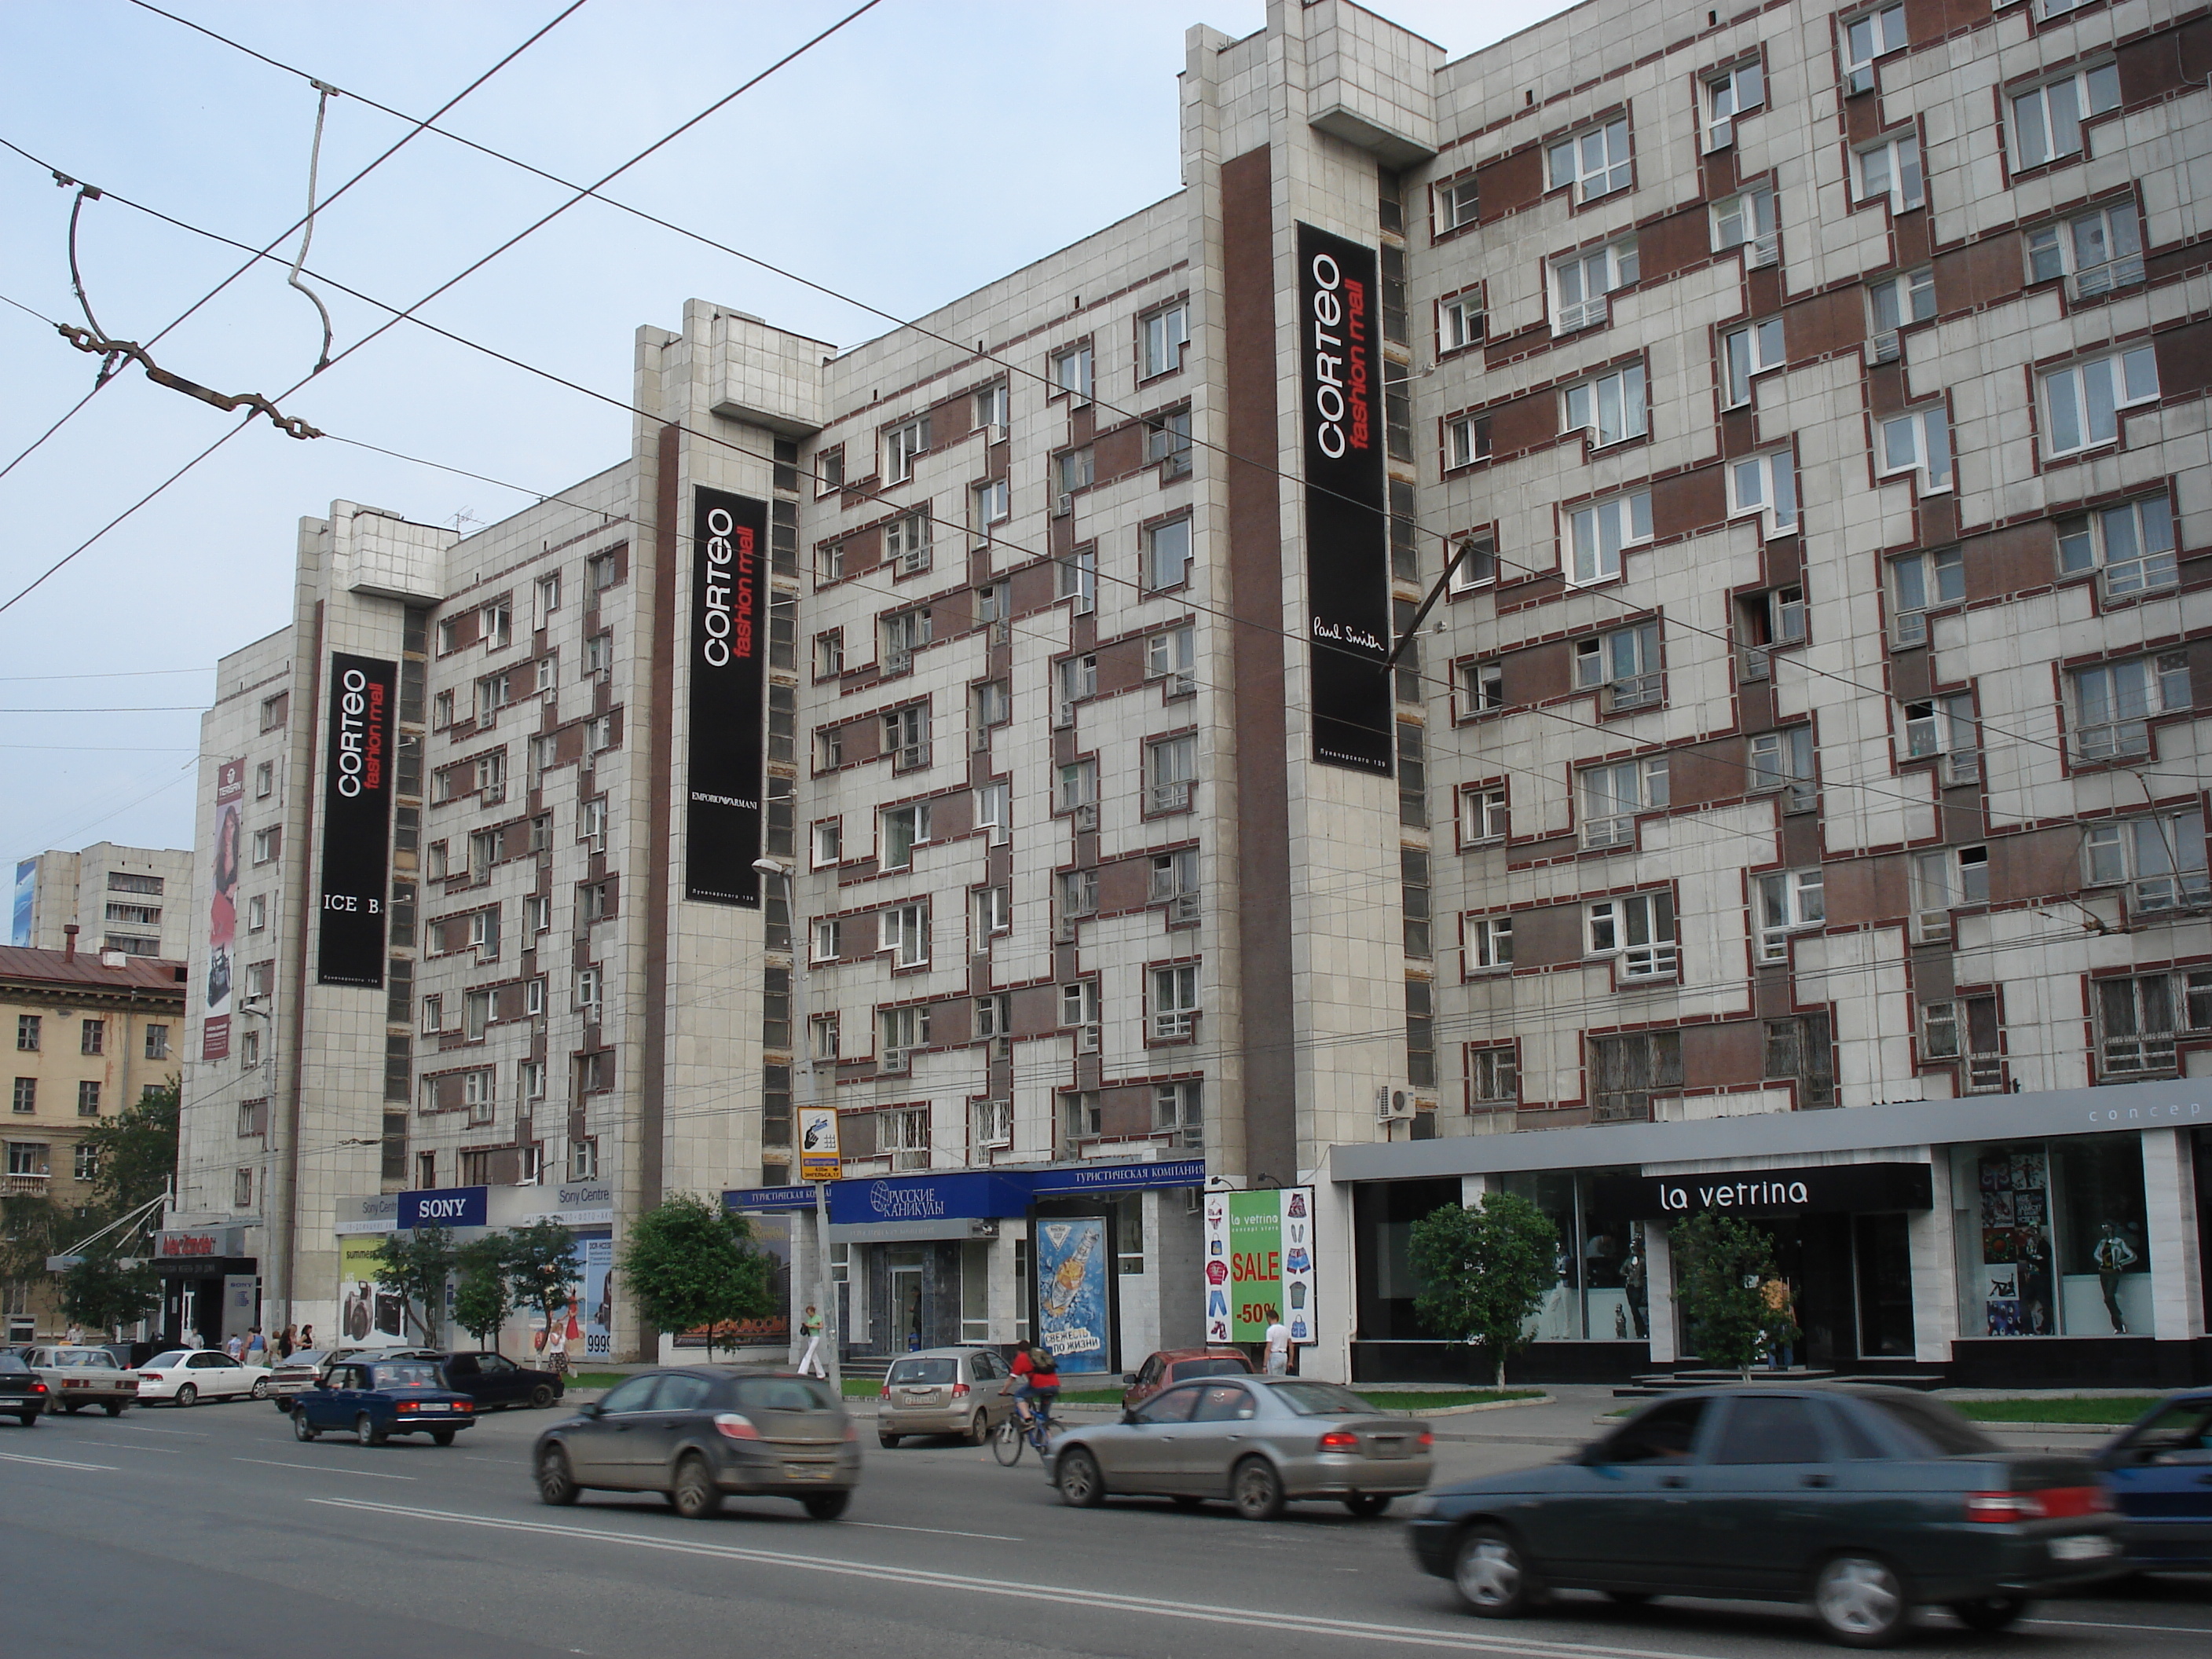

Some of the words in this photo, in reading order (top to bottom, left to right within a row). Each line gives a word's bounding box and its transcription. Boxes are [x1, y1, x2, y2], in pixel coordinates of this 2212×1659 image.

[1344, 277, 1365, 342] mall
[1347, 345, 1368, 449] fashion
[736, 526, 754, 573] mall
[732, 578, 753, 657] fashion
[1313, 616, 1342, 640] Paul
[1346, 625, 1385, 651] Smith
[368, 683, 384, 721] mall
[362, 725, 382, 789] fashion
[729, 797, 757, 810] ARMANI
[324, 894, 357, 912] ICE
[2089, 1103, 2200, 1122] concep
[1075, 1168, 1148, 1184] ТУРИСТИЧЕСКАЯ
[1152, 1164, 1205, 1177] КОМПАНИЯ
[559, 1189, 580, 1205] Sony
[581, 1188, 610, 1202] Centre
[752, 1190, 804, 1203] ТУРИСТИЧЕСКАЯ
[888, 1188, 935, 1203] РУССКИЕ
[1660, 1183, 1688, 1210] la
[1699, 1181, 1808, 1207] vetrina
[363, 1202, 379, 1216] Sony
[419, 1198, 467, 1218] SONY
[884, 1201, 944, 1218] КАНИКУЛЫ
[1231, 1214, 1240, 1225] la
[1243, 1214, 1279, 1225] vetrina
[1232, 1251, 1280, 1283] SALE
[1046, 1328, 1089, 1344] СВЕЖЕСТЬ
[1053, 1343, 1065, 1353] ПО
[1067, 1338, 1098, 1350] ЖИЗНИ
